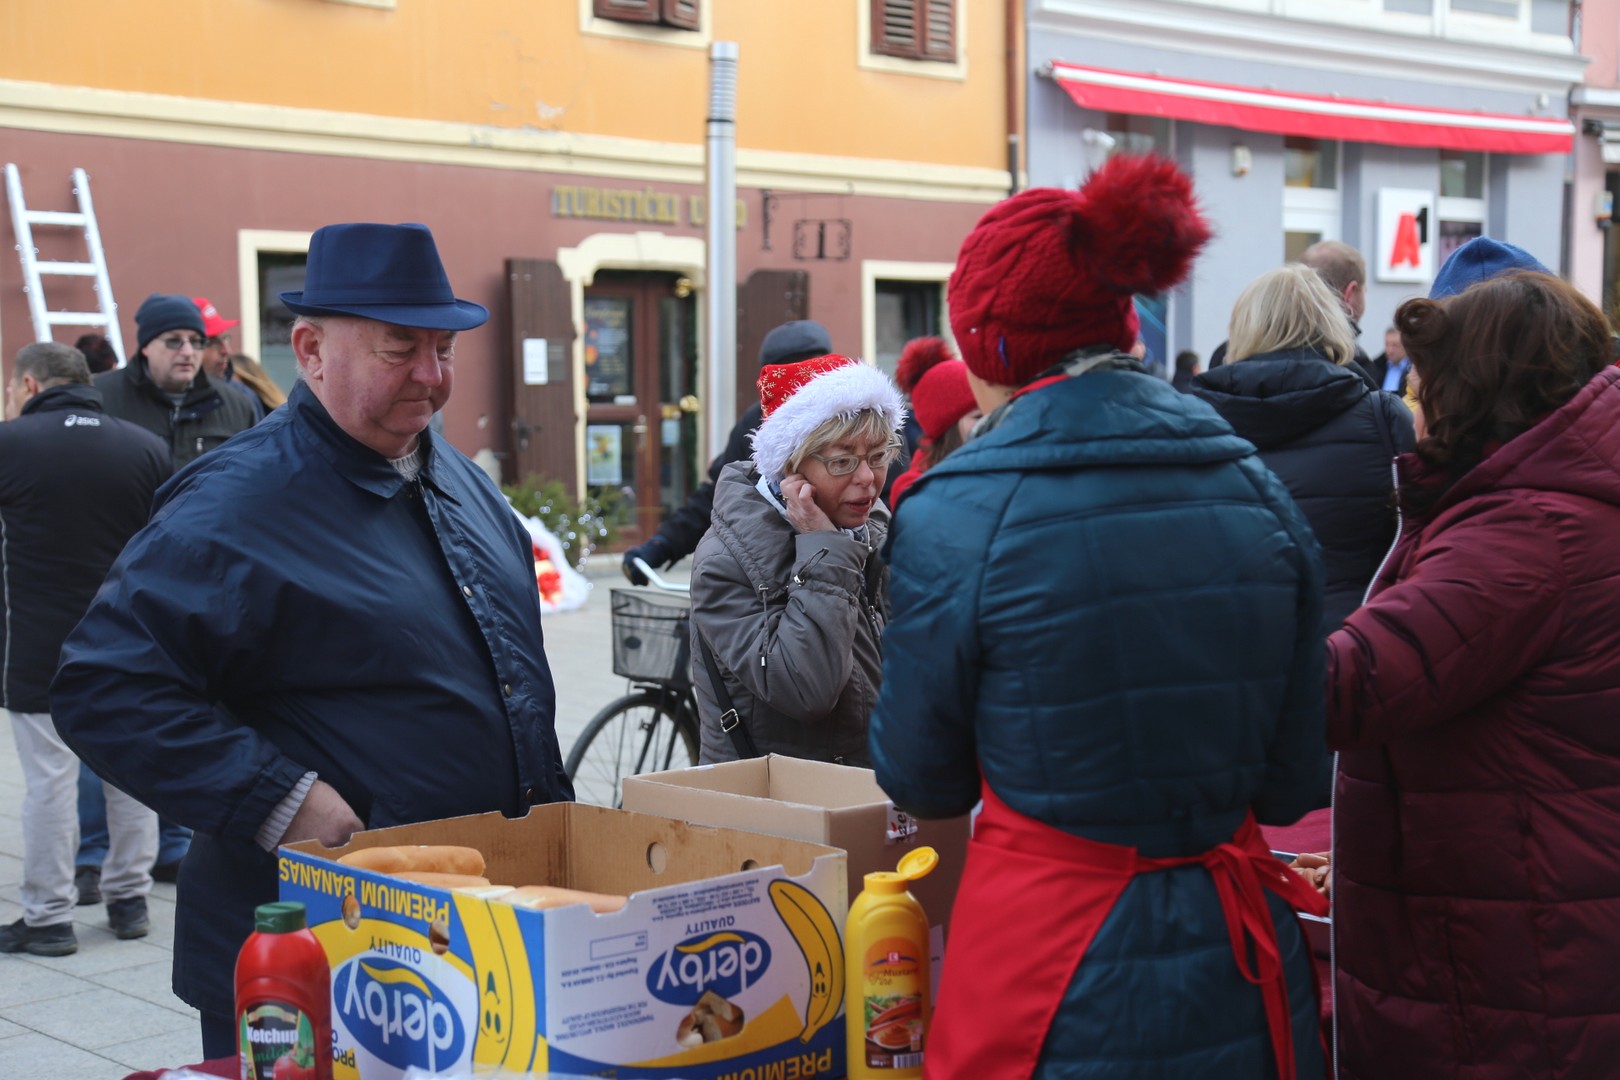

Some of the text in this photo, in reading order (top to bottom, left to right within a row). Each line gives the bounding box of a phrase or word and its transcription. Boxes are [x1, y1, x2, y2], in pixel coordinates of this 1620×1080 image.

[553, 184, 748, 230] TURISTIČKI UD
[1389, 206, 1428, 268] A1
[76, 416, 100, 427] asics
[278, 857, 449, 926] PREMIUM BANANAS
[685, 915, 735, 935] QUALITY
[369, 936, 421, 964] QUALITY
[656, 940, 763, 994] derby
[343, 957, 454, 1073] derby
[246, 1026, 299, 1044] Ketchup
[332, 1047, 355, 1068] PRO
